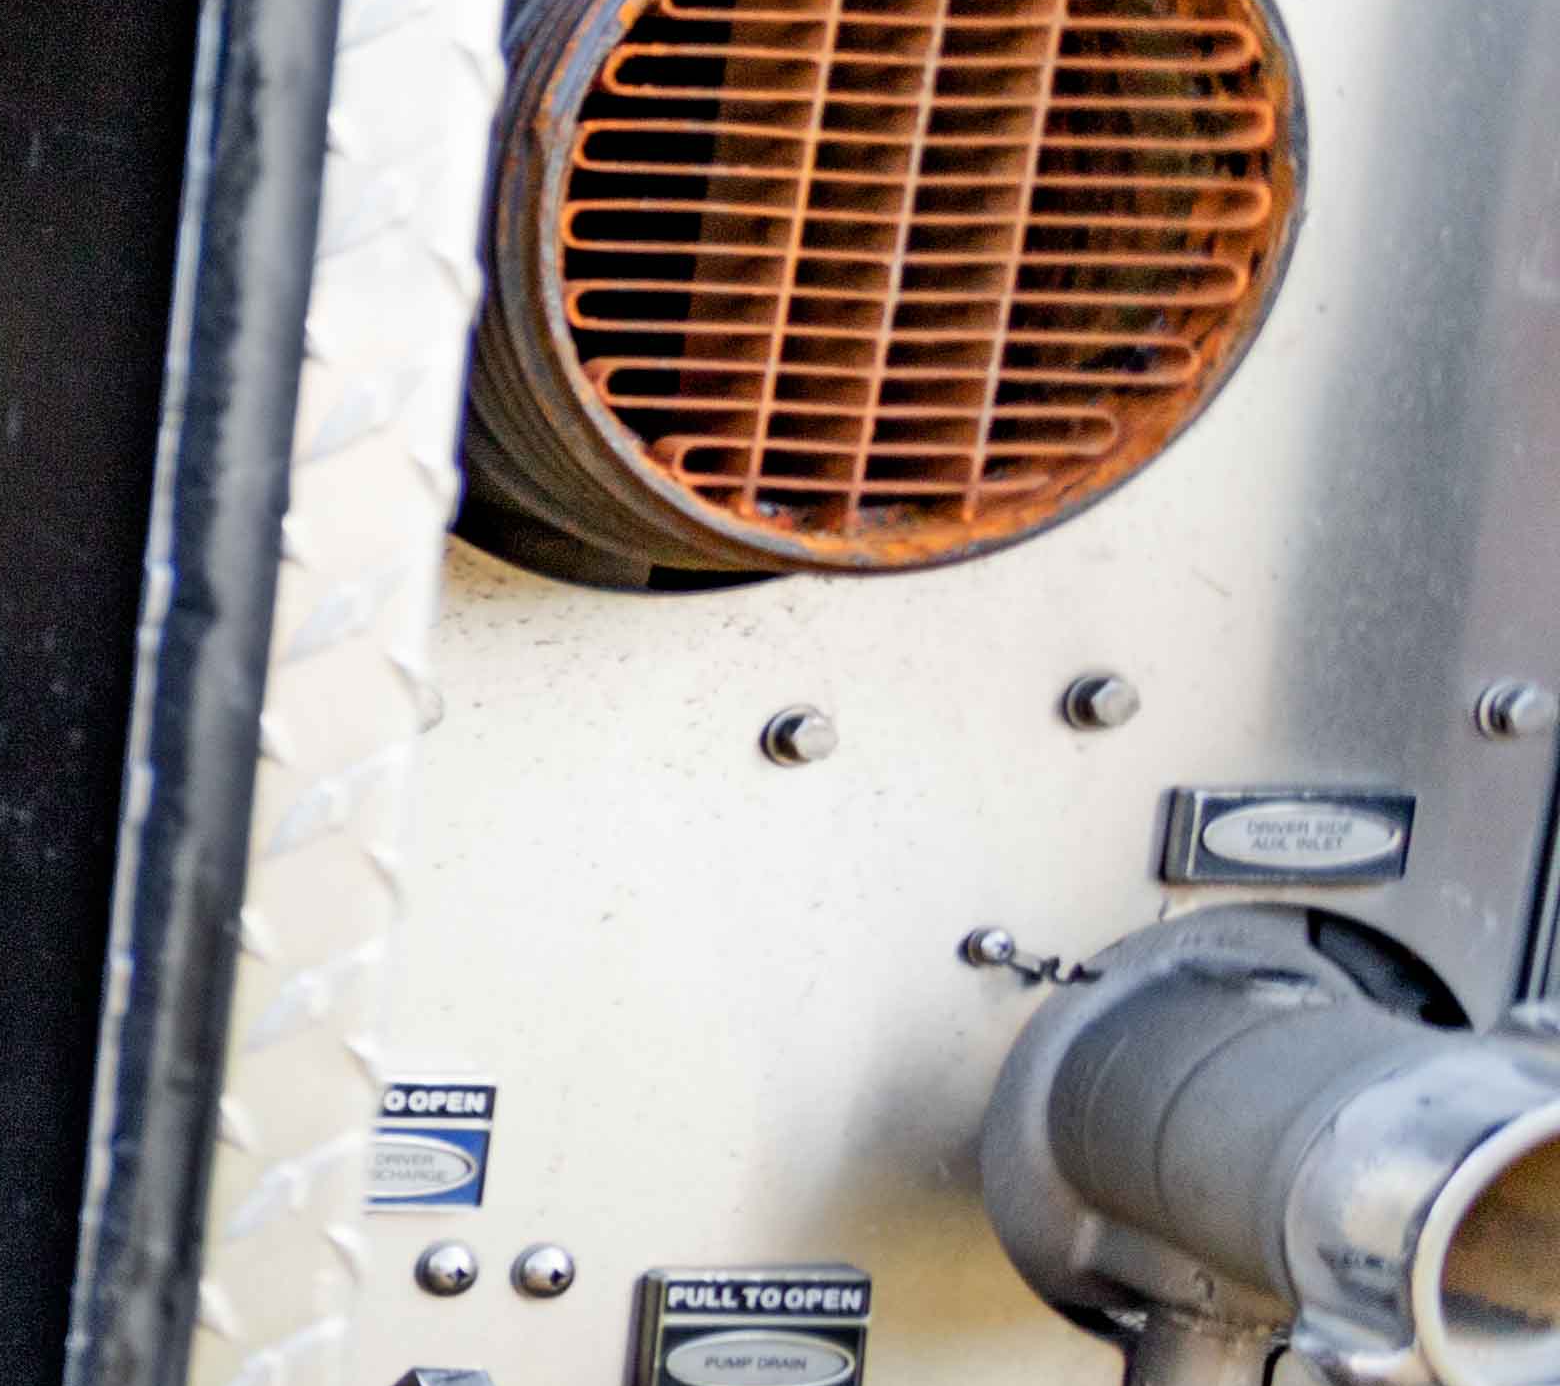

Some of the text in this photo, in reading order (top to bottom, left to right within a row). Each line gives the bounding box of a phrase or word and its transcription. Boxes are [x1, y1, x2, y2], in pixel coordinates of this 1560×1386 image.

[1247, 819, 1352, 836] DRIVER SIDE
[1296, 836, 1344, 851] INLET
[384, 1089, 487, 1113] O OPEN
[667, 1285, 863, 1310] PULL TO OPEN
[704, 1356, 808, 1372] PUMP DRAIN
